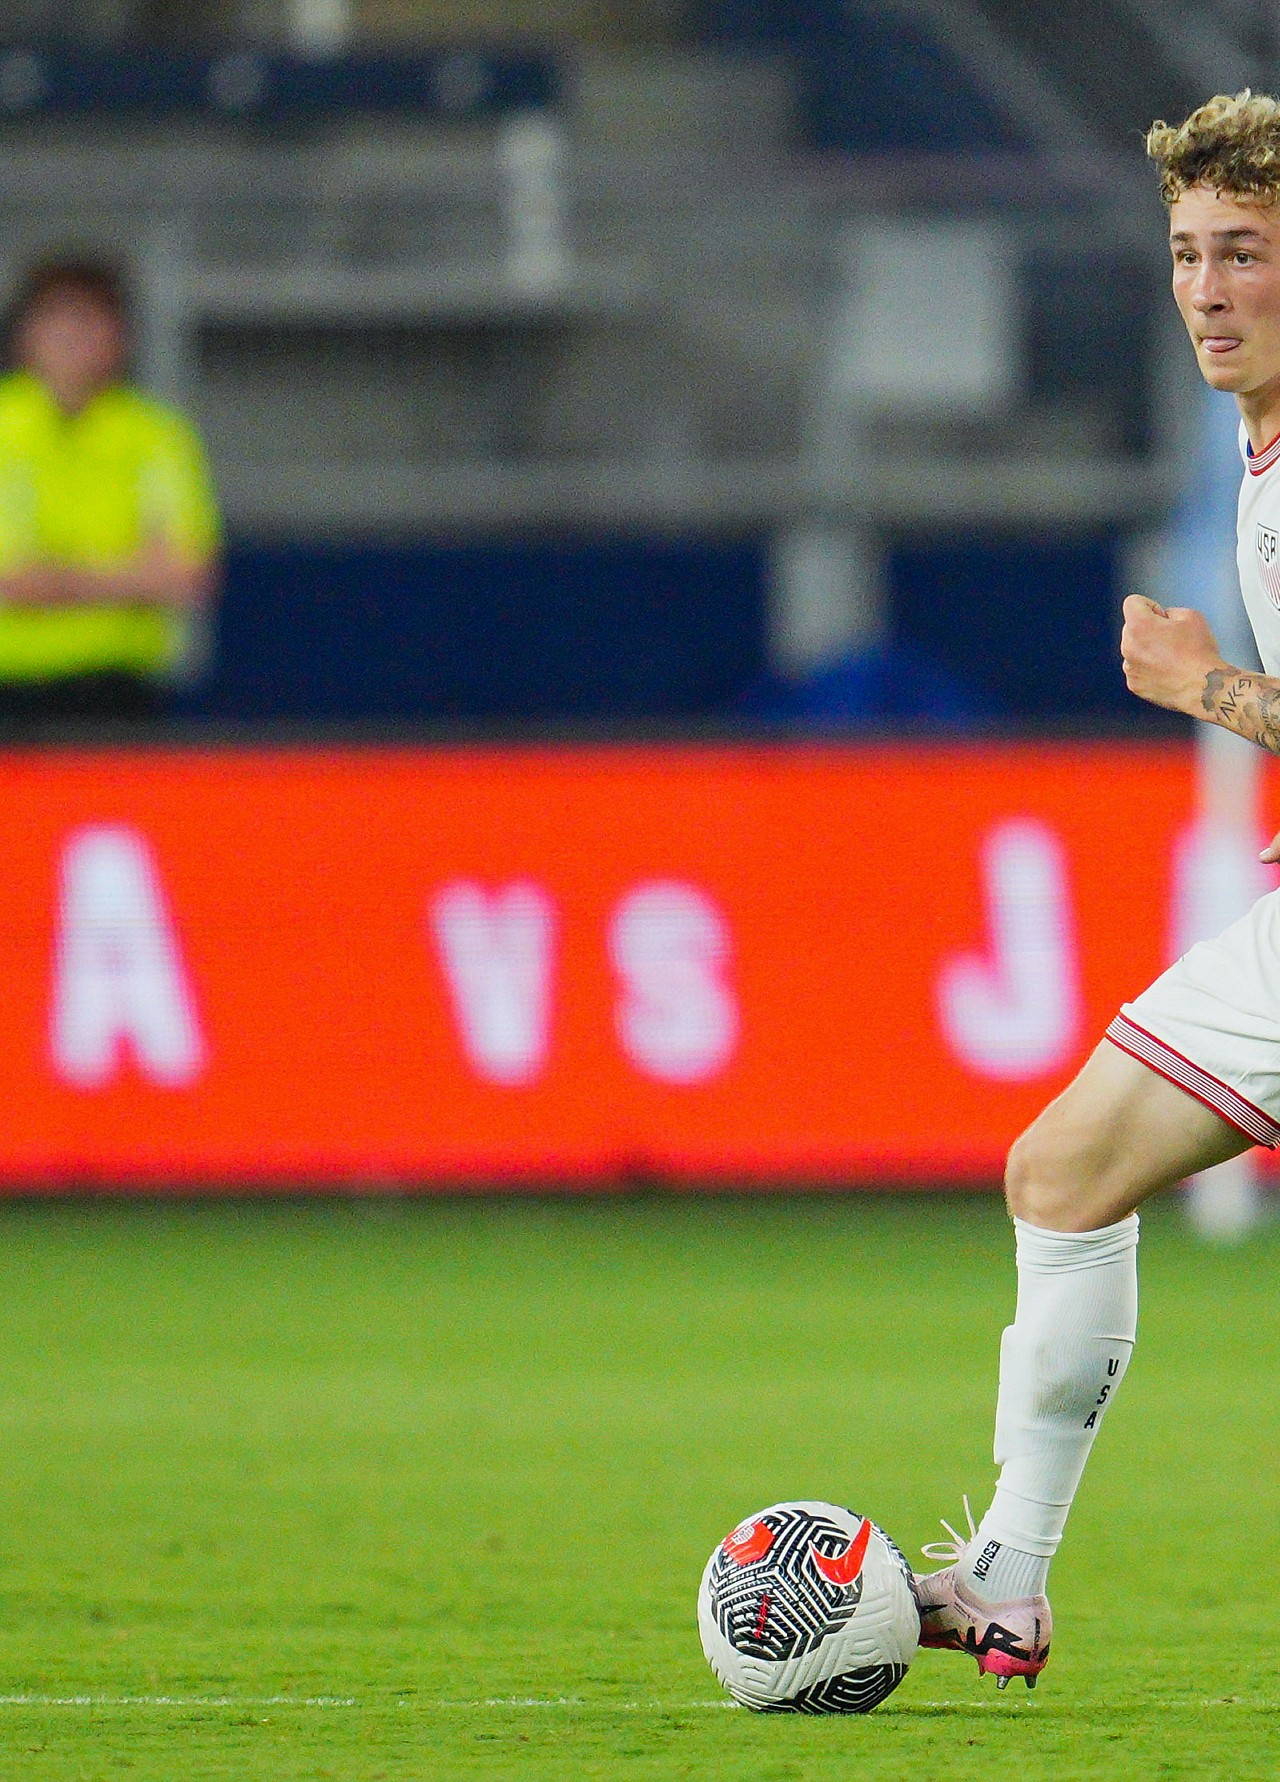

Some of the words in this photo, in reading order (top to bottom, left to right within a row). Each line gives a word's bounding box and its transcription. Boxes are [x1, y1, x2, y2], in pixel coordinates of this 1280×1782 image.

[1256, 530, 1277, 563] USA
[48, 824, 204, 1087] A
[1083, 1358, 1119, 1429] USA
[972, 1539, 1002, 1581] ESIGN
